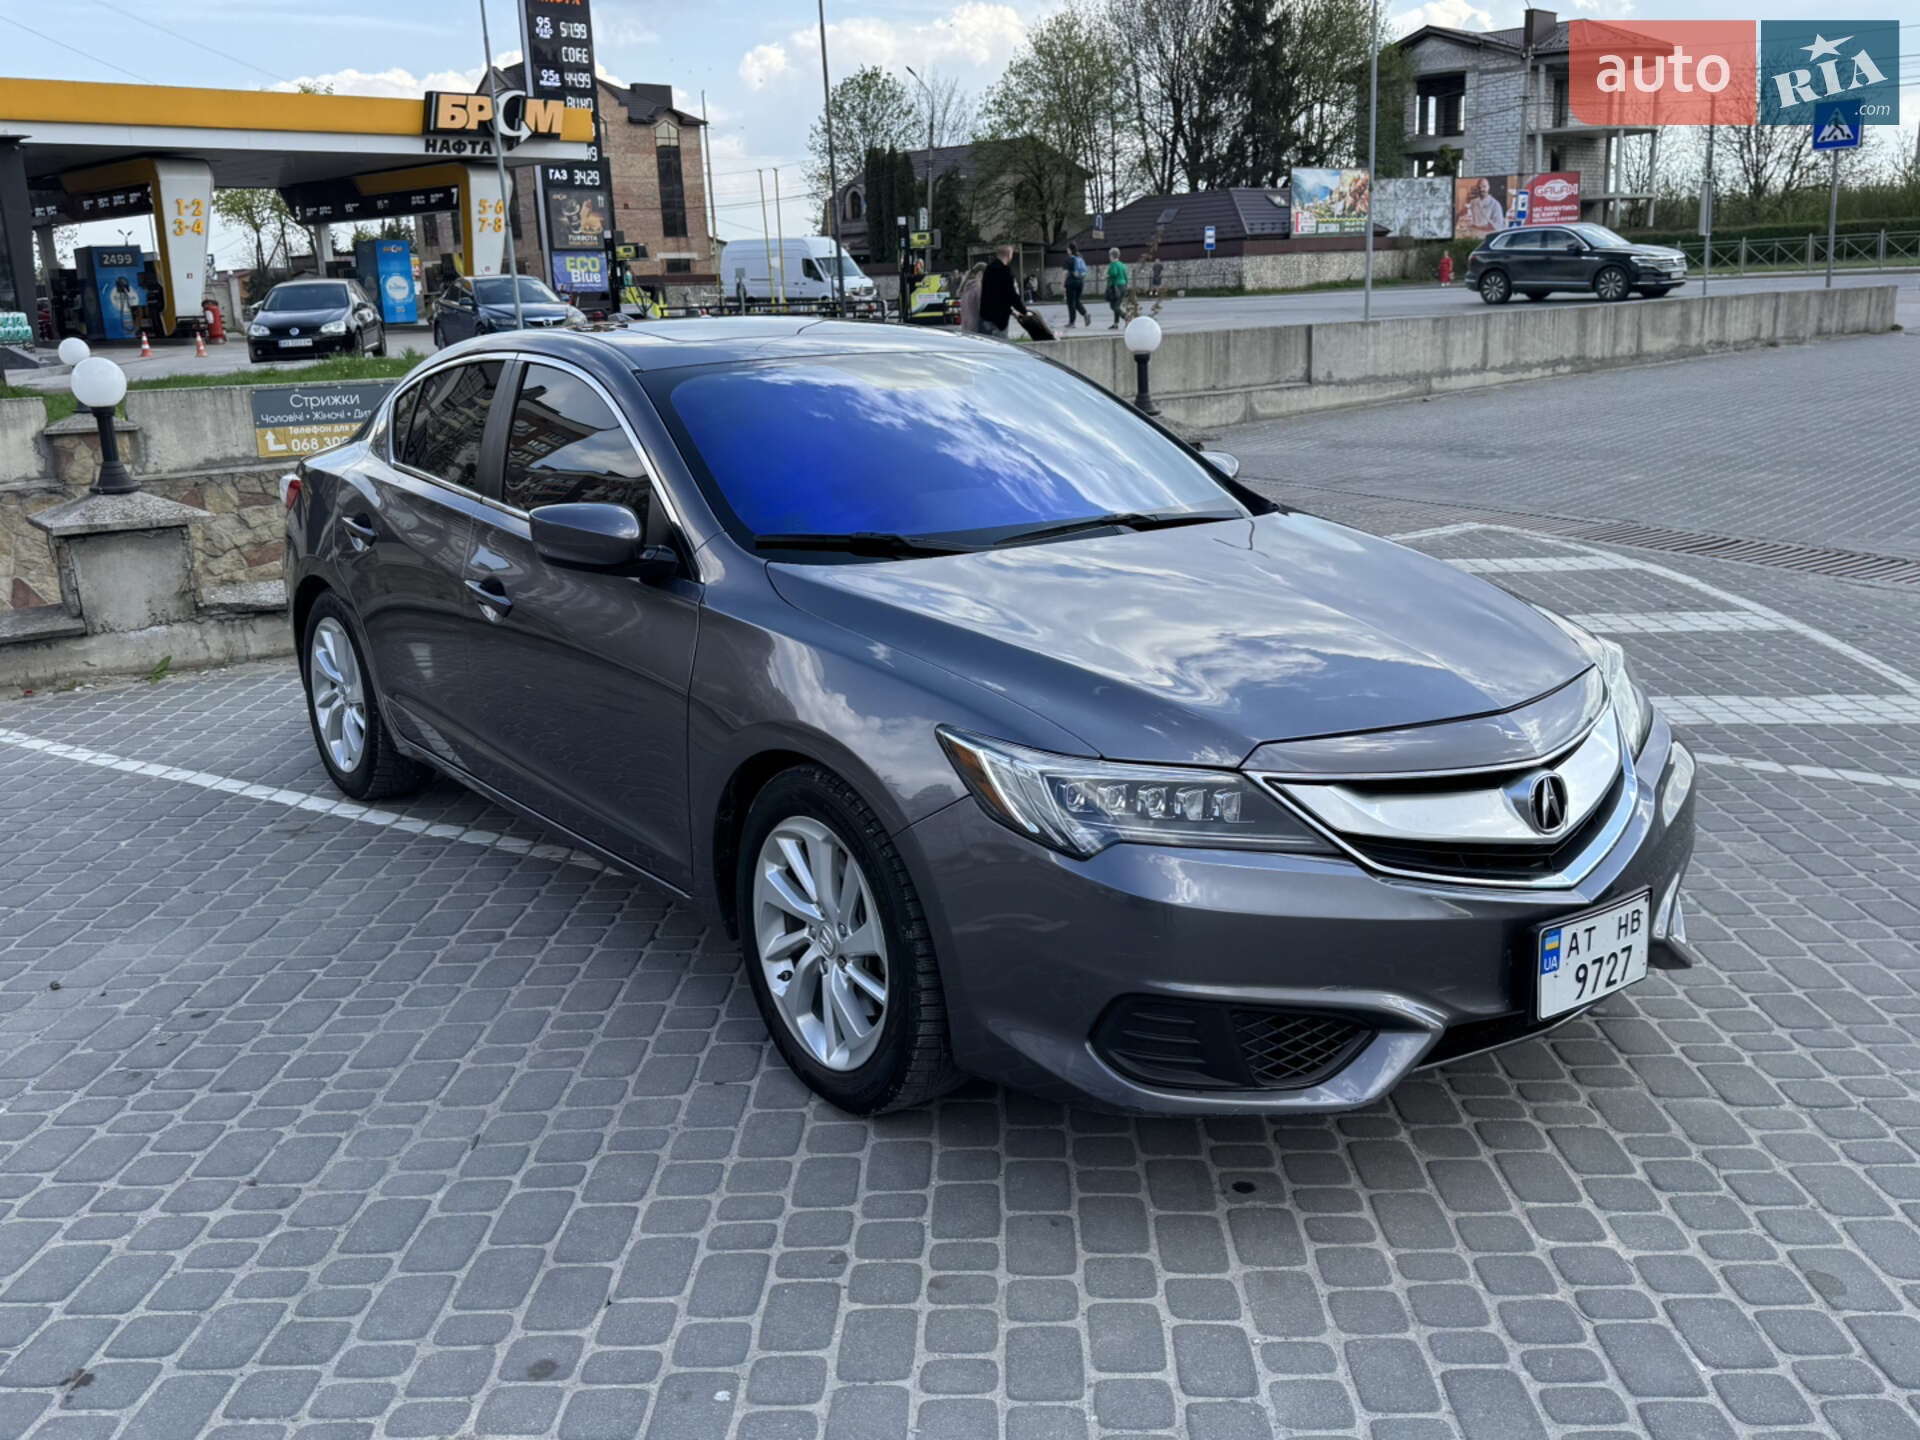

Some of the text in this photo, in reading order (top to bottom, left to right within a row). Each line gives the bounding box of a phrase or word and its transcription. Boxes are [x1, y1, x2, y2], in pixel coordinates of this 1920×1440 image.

[536, 16, 551, 29] 95
[425, 138, 492, 154] НАФТА
[549, 169, 568, 181] ГАЗ
[176, 199, 203, 216] 1-2
[479, 199, 504, 215] 5-6
[173, 218, 204, 236] 3-4
[479, 217, 503, 233] 7-8
[566, 256, 600, 272] ECO
[571, 270, 600, 283] Blue
[289, 394, 360, 409] Стрижки
[261, 411, 304, 424] Чоловічі
[312, 410, 345, 421] Жіночі
[289, 425, 331, 435] Телефон
[333, 424, 350, 433] для
[291, 437, 319, 452] 068
[1567, 908, 1641, 958] AT HB
[1543, 956, 1558, 971] UA
[1575, 944, 1633, 1000] 9727
